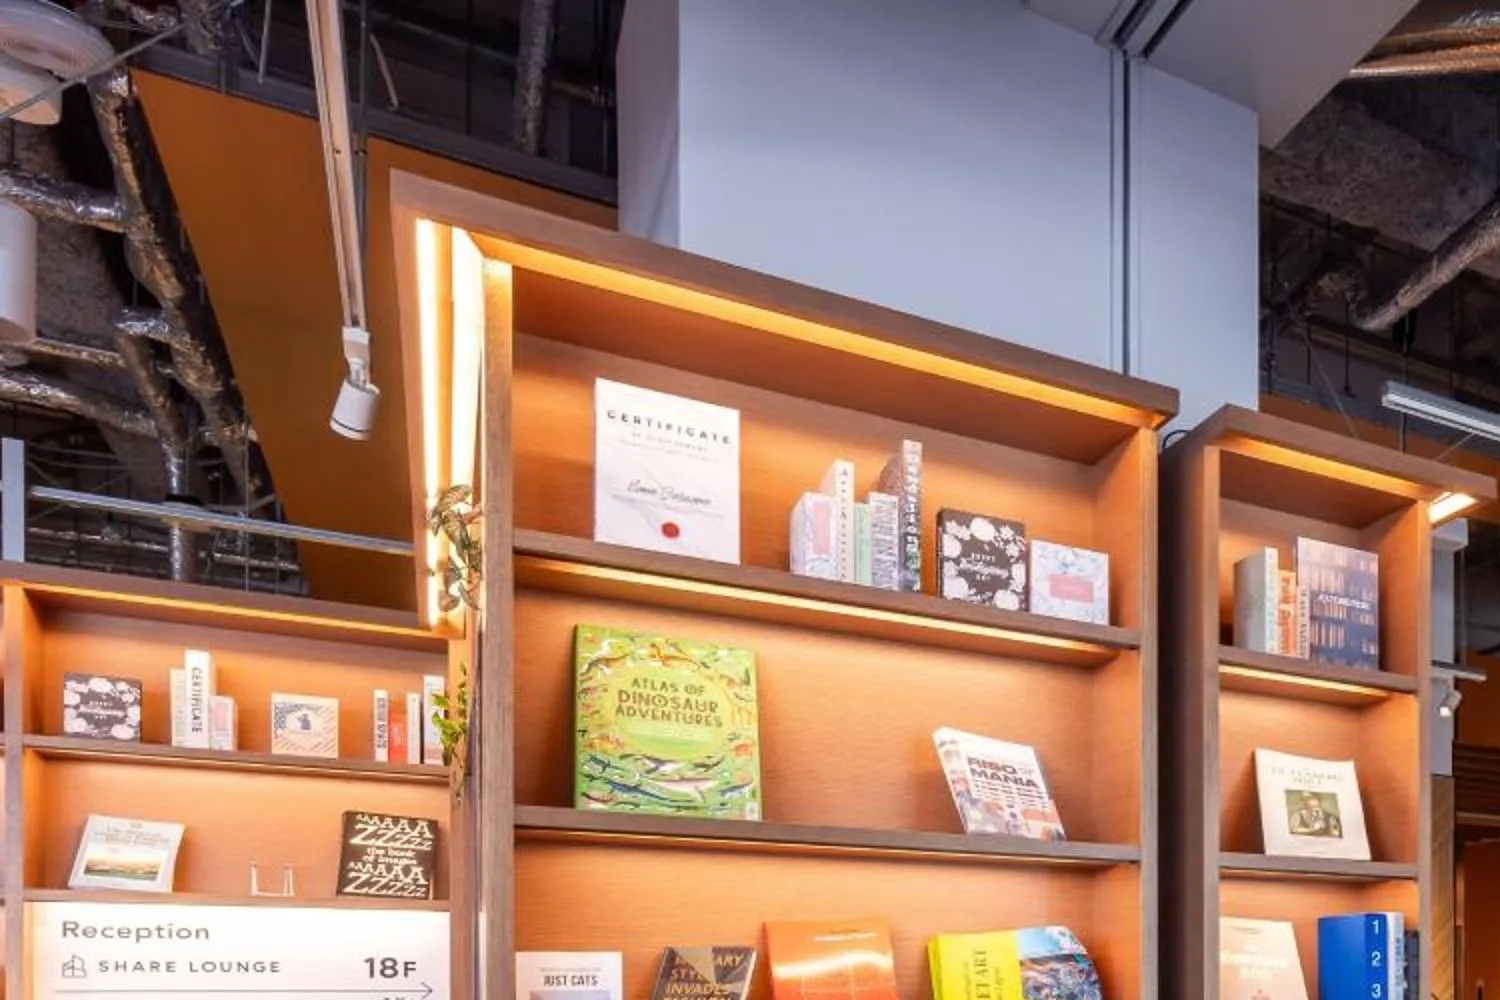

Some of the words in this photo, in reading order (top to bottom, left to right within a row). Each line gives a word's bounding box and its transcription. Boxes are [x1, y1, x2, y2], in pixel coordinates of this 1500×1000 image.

[606, 408, 732, 445] CERTIFICATE
[632, 677, 679, 693] ATLAS
[684, 683, 705, 695] OF
[190, 666, 203, 733] CERTIFICATE
[618, 689, 719, 713] DINOSAUR
[615, 704, 723, 727] ADVENTURES
[970, 767, 1040, 789] MANIA
[61, 920, 211, 944] Reception
[1371, 919, 1380, 935] 1
[98, 960, 177, 974] SHARE
[189, 960, 281, 974] LOUNGE
[363, 957, 417, 979] 18F
[974, 949, 988, 977] ART
[1371, 951, 1382, 967] 2
[544, 975, 567, 986] JUST
[571, 975, 599, 986] CATS
[1371, 983, 1382, 999] 3
